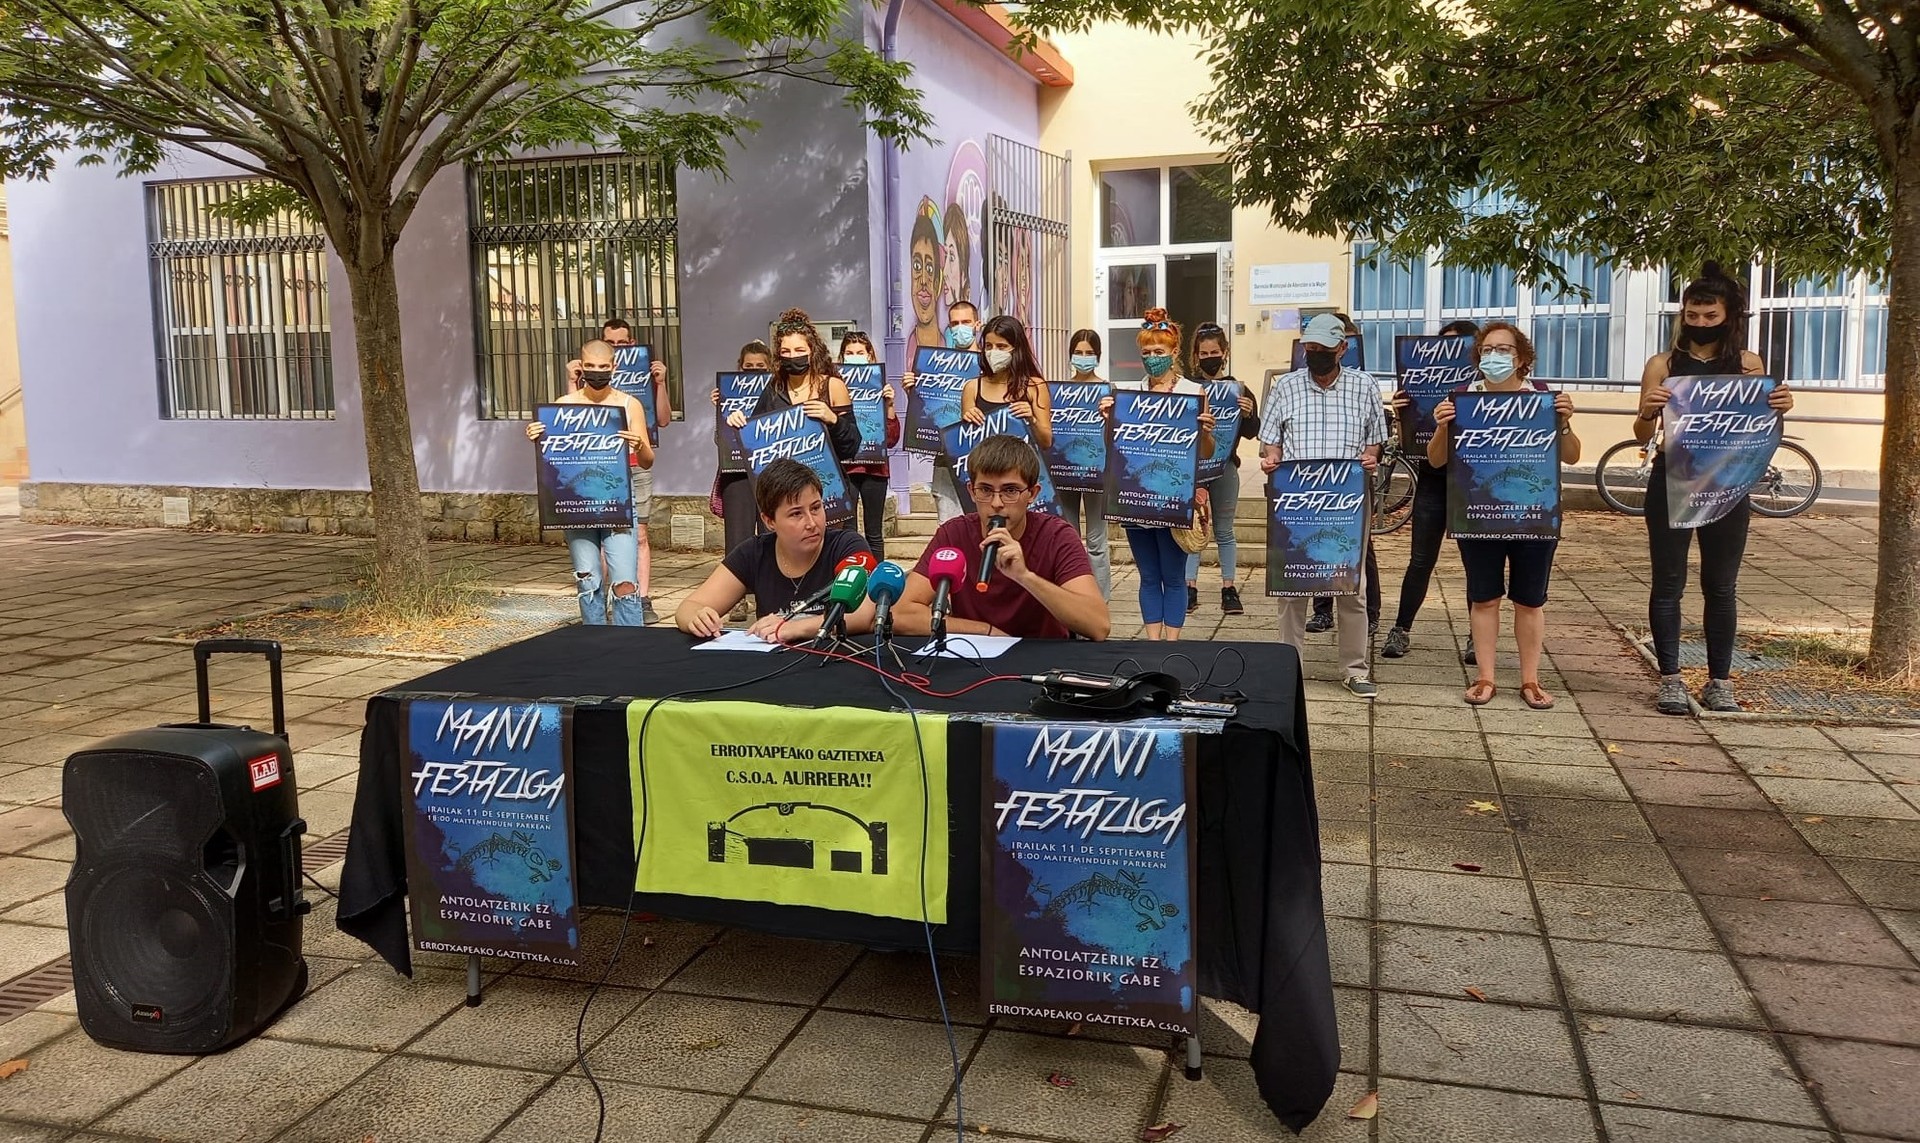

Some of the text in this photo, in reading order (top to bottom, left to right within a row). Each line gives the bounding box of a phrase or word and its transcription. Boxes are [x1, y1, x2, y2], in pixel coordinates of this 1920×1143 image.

[928, 350, 973, 372] MANI
[1412, 337, 1463, 364] MANI
[731, 374, 772, 395] MAN
[1401, 366, 1479, 387] FESTAZIGA
[1054, 384, 1099, 407] MANI
[1690, 378, 1762, 409] MANI
[720, 396, 760, 418] FESTA
[1050, 408, 1105, 427] ESTAZIG
[1129, 395, 1188, 421] MANI
[1471, 394, 1541, 424] MANI
[554, 407, 609, 431] MANI
[755, 406, 805, 442] MANI
[959, 409, 1007, 448] MANI
[1671, 411, 1778, 437] FESTAZIGA
[540, 432, 625, 454] FESTAZIGA
[1114, 423, 1198, 449] FESTAZIGA
[1454, 426, 1556, 451] FESTAZIGA
[748, 432, 825, 469] FESTAZIGA
[1289, 462, 1351, 489] MANI
[1118, 499, 1159, 507] ESPAZIORIK
[1119, 491, 1169, 500] ANTOLATZERIK
[1273, 491, 1364, 514] FESTAZIGA
[435, 701, 541, 756] MANI
[711, 744, 885, 762] ERROTXAPEAKO GAZTETXEA
[1025, 724, 1156, 784] MANI
[254, 761, 276, 780] LAB
[726, 770, 872, 788] C.S.O.A. AURRERA!!
[411, 760, 565, 809] FESTAZIGA
[427, 806, 462, 816] IRAILAK
[497, 811, 550, 822] SEPTIEMBRE
[453, 817, 512, 828] MAITEMINDUEN
[994, 788, 1186, 844] FESTAZIGA
[1012, 842, 1166, 859] IRAILAK 11 DE SEPTIEMBRE
[1044, 854, 1119, 866] MAITEMINDUEN
[1123, 860, 1167, 869] PARKEAN
[440, 895, 550, 914] ANTOLATZERIK EZ
[440, 910, 552, 930] ESPAZIORIK GABE
[420, 941, 494, 956] ERROTXAPEAKO
[496, 950, 551, 963] GAZTETXEA
[1020, 947, 1159, 969] ANTOLATZERIK EZ
[1020, 965, 1161, 987] ESPAZIORIK GABE
[989, 1004, 1082, 1021] ERROTXAPEAKO
[1086, 1013, 1155, 1029] GAZTETXEA
